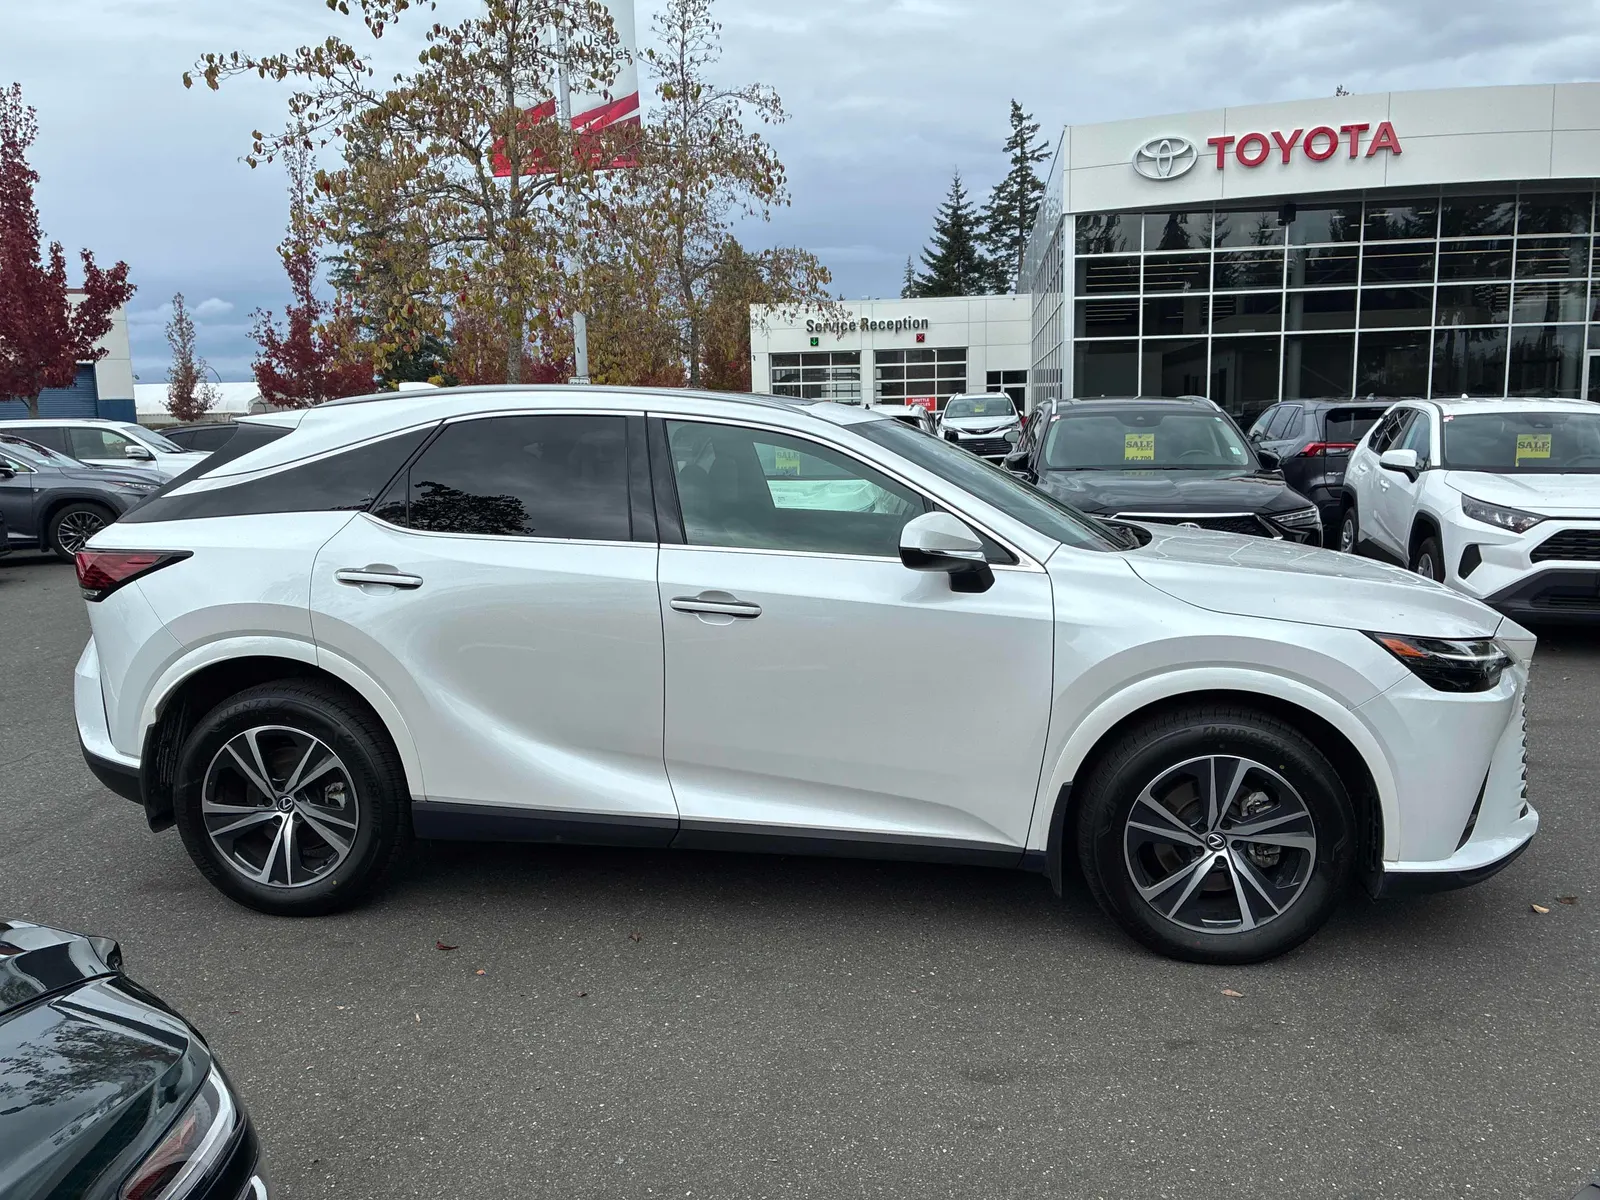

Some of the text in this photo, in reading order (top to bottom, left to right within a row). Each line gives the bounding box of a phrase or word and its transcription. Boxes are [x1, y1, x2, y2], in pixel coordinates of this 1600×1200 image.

[1207, 121, 1402, 171] TOYOTA
[806, 315, 929, 334] Service Reception
[1126, 440, 1153, 449] SALE
[1517, 441, 1550, 449] SALE
